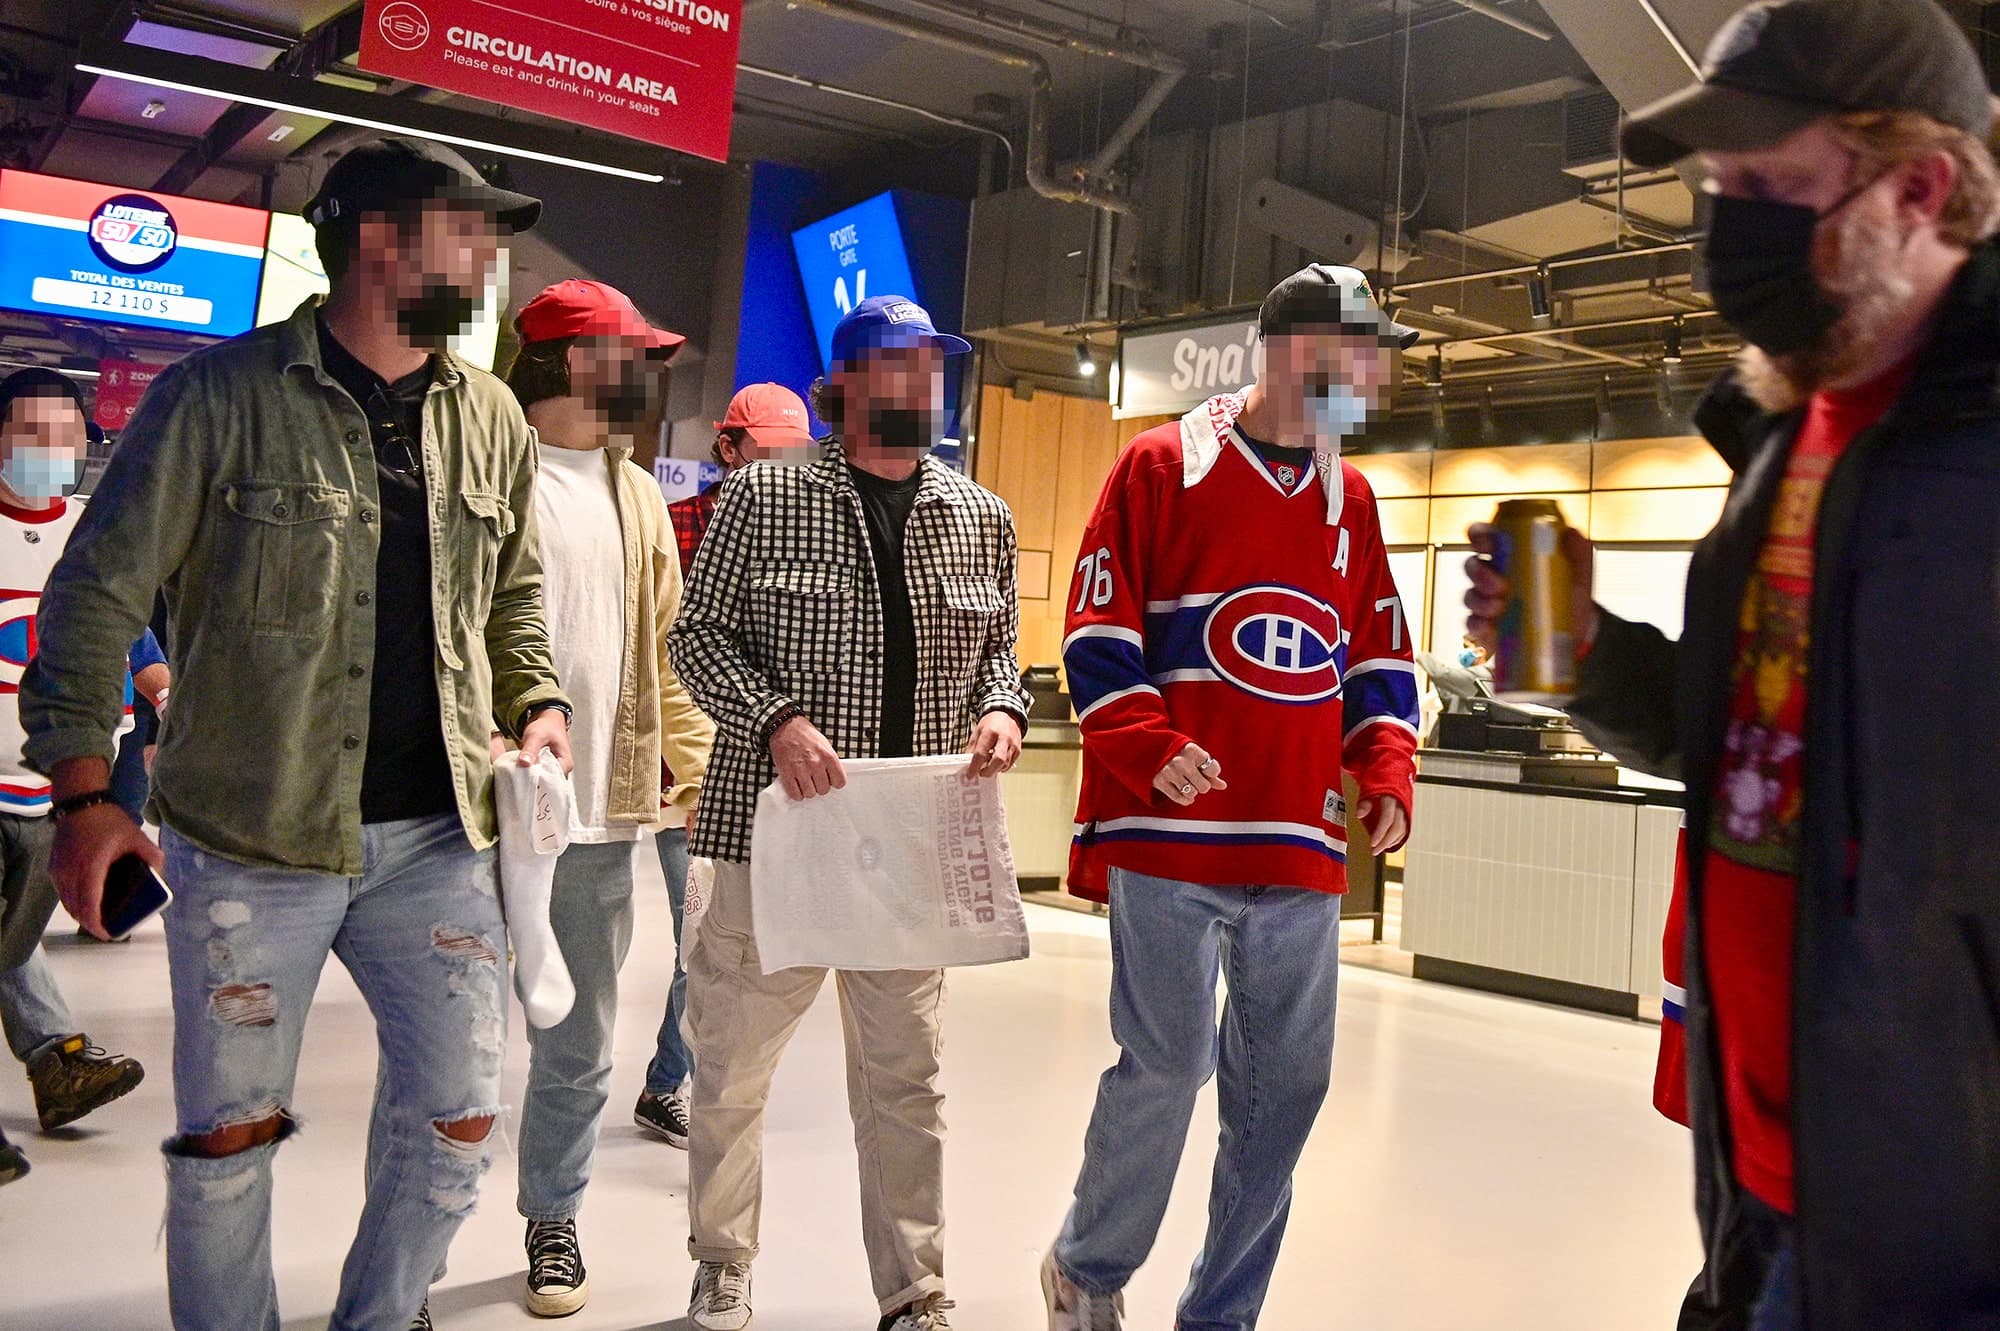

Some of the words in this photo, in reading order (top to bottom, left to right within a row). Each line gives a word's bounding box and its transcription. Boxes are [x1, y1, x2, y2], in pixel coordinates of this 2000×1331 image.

[620, 4, 628, 15] à
[632, 8, 651, 22] vos
[655, 15, 692, 35] sièges
[446, 26, 612, 86] CIRCULATION
[616, 72, 679, 106] AREA
[444, 49, 489, 71] Please
[492, 63, 514, 78] eat
[517, 69, 543, 85] and
[546, 76, 579, 94] drink
[583, 85, 594, 98] in
[597, 91, 626, 107] your
[628, 100, 660, 117] seats
[829, 223, 859, 252] PORTE
[70, 269, 109, 285] TOTAL
[111, 275, 136, 289] DES
[138, 279, 184, 296] VENTES
[91, 290, 112, 306] 12
[120, 294, 153, 311] 110
[159, 299, 169, 314] $
[130, 371, 159, 381] ZON
[658, 463, 686, 486] 116
[1331, 526, 1351, 579] A
[1075, 546, 1113, 613] 76
